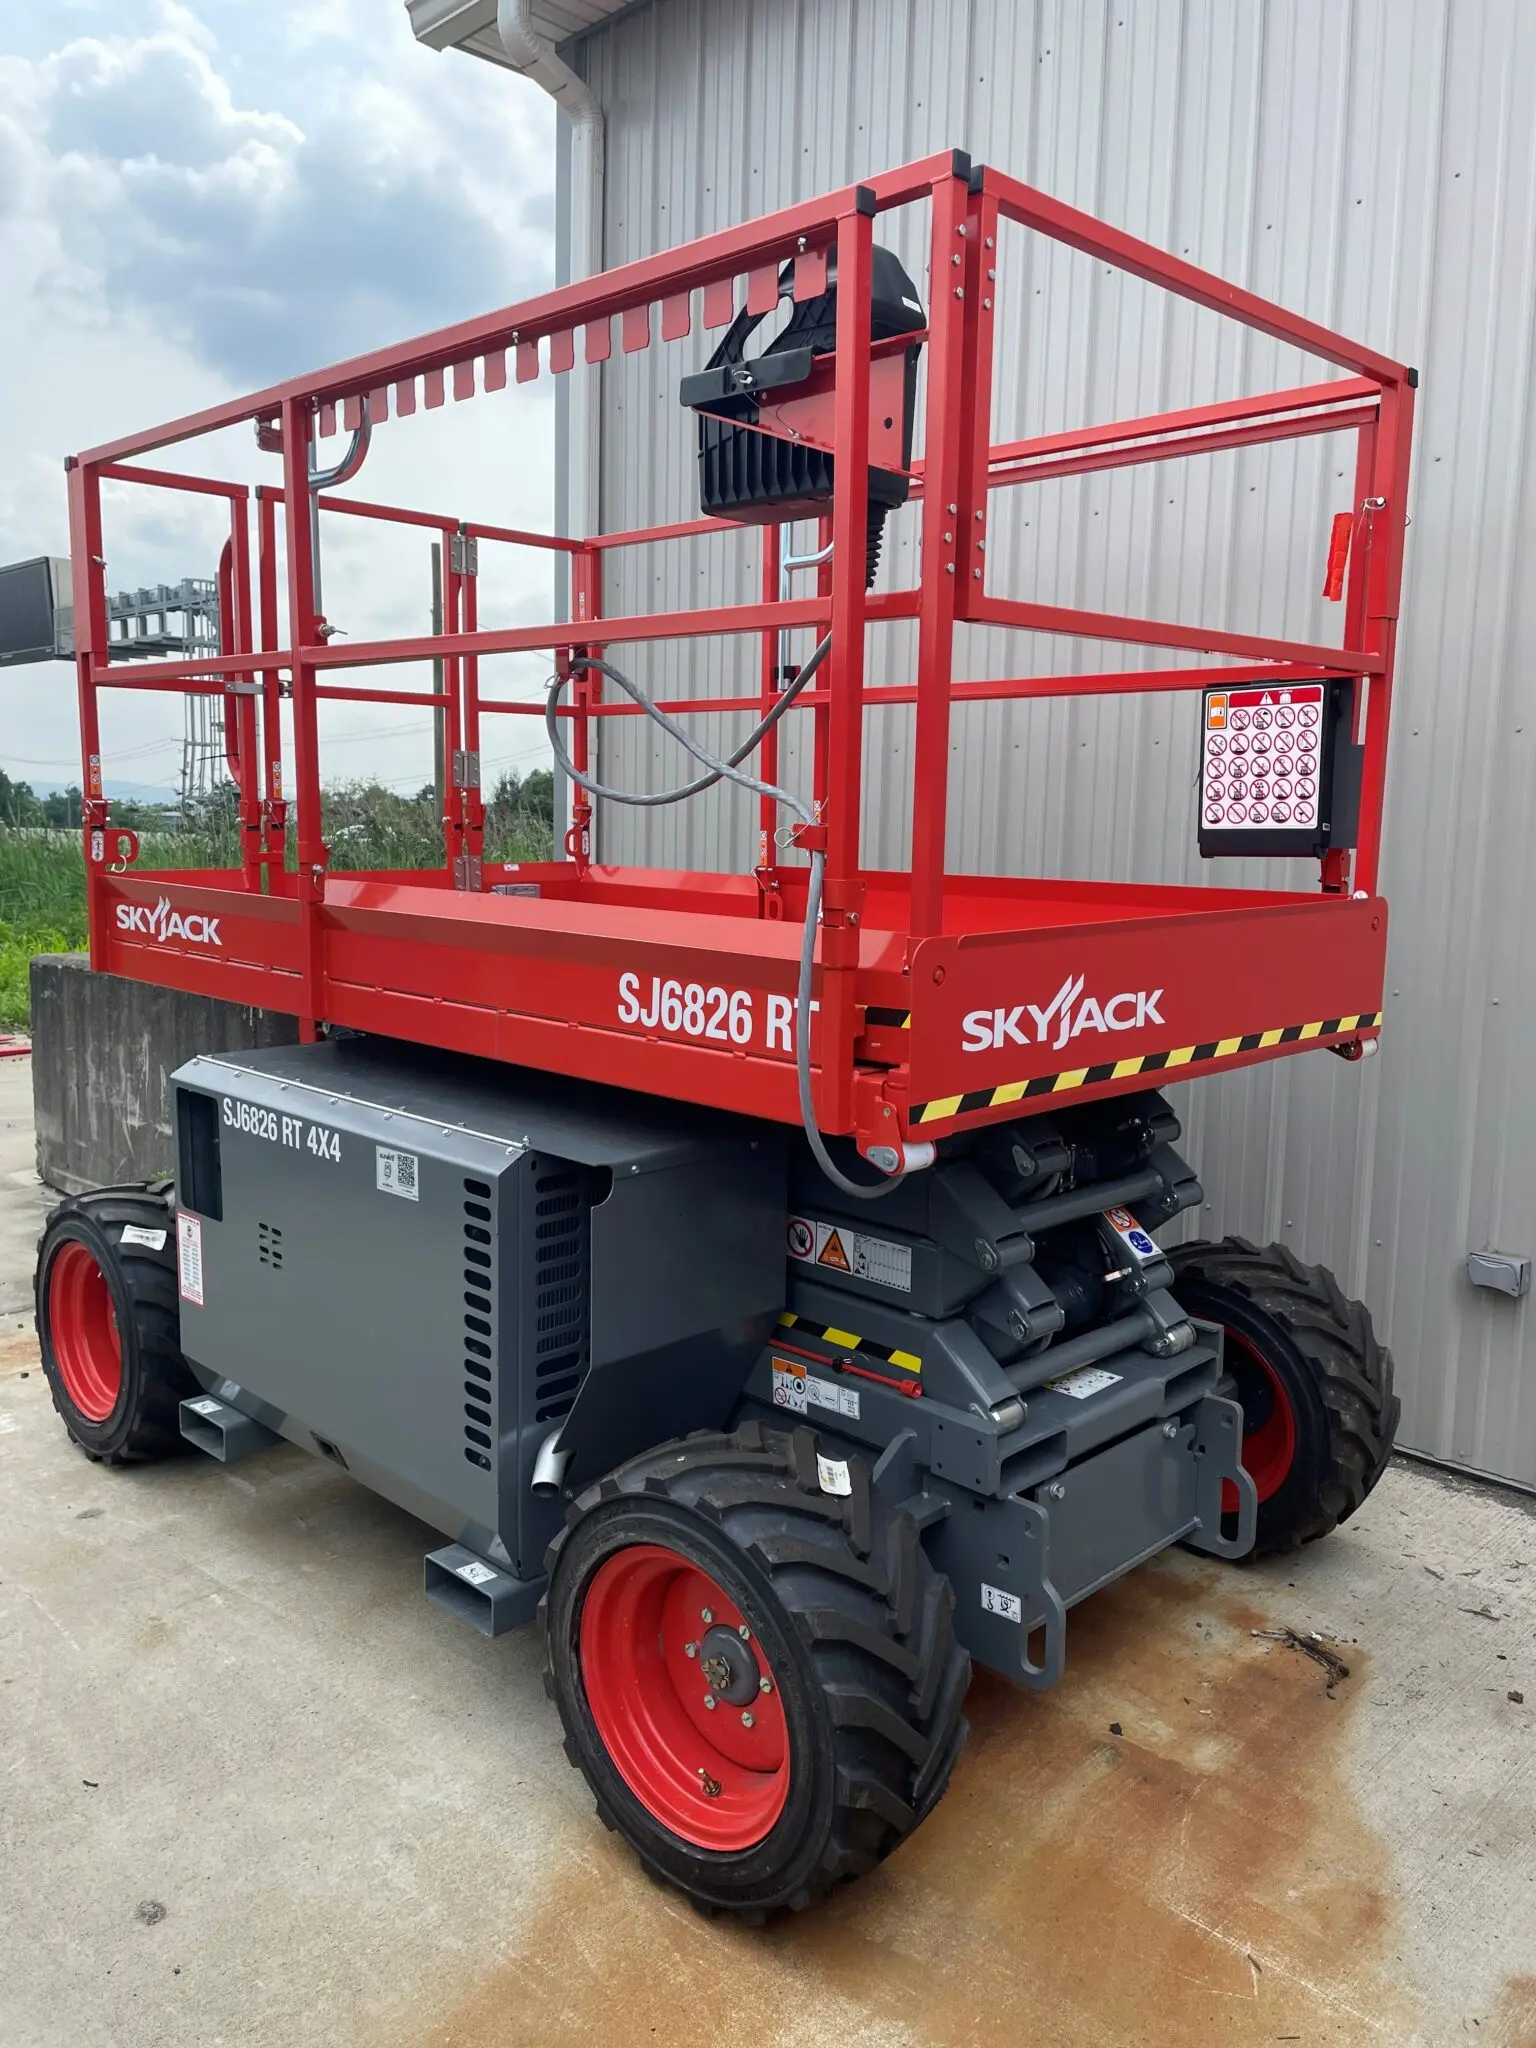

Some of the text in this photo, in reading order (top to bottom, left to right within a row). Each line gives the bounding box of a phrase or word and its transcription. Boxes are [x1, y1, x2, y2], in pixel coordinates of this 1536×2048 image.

[116, 895, 222, 945] SKYJACK
[618, 972, 752, 1044] SJ6826
[962, 973, 1165, 1051] SKYJACK
[223, 1097, 341, 1162] SJ6826 RT 4X4
